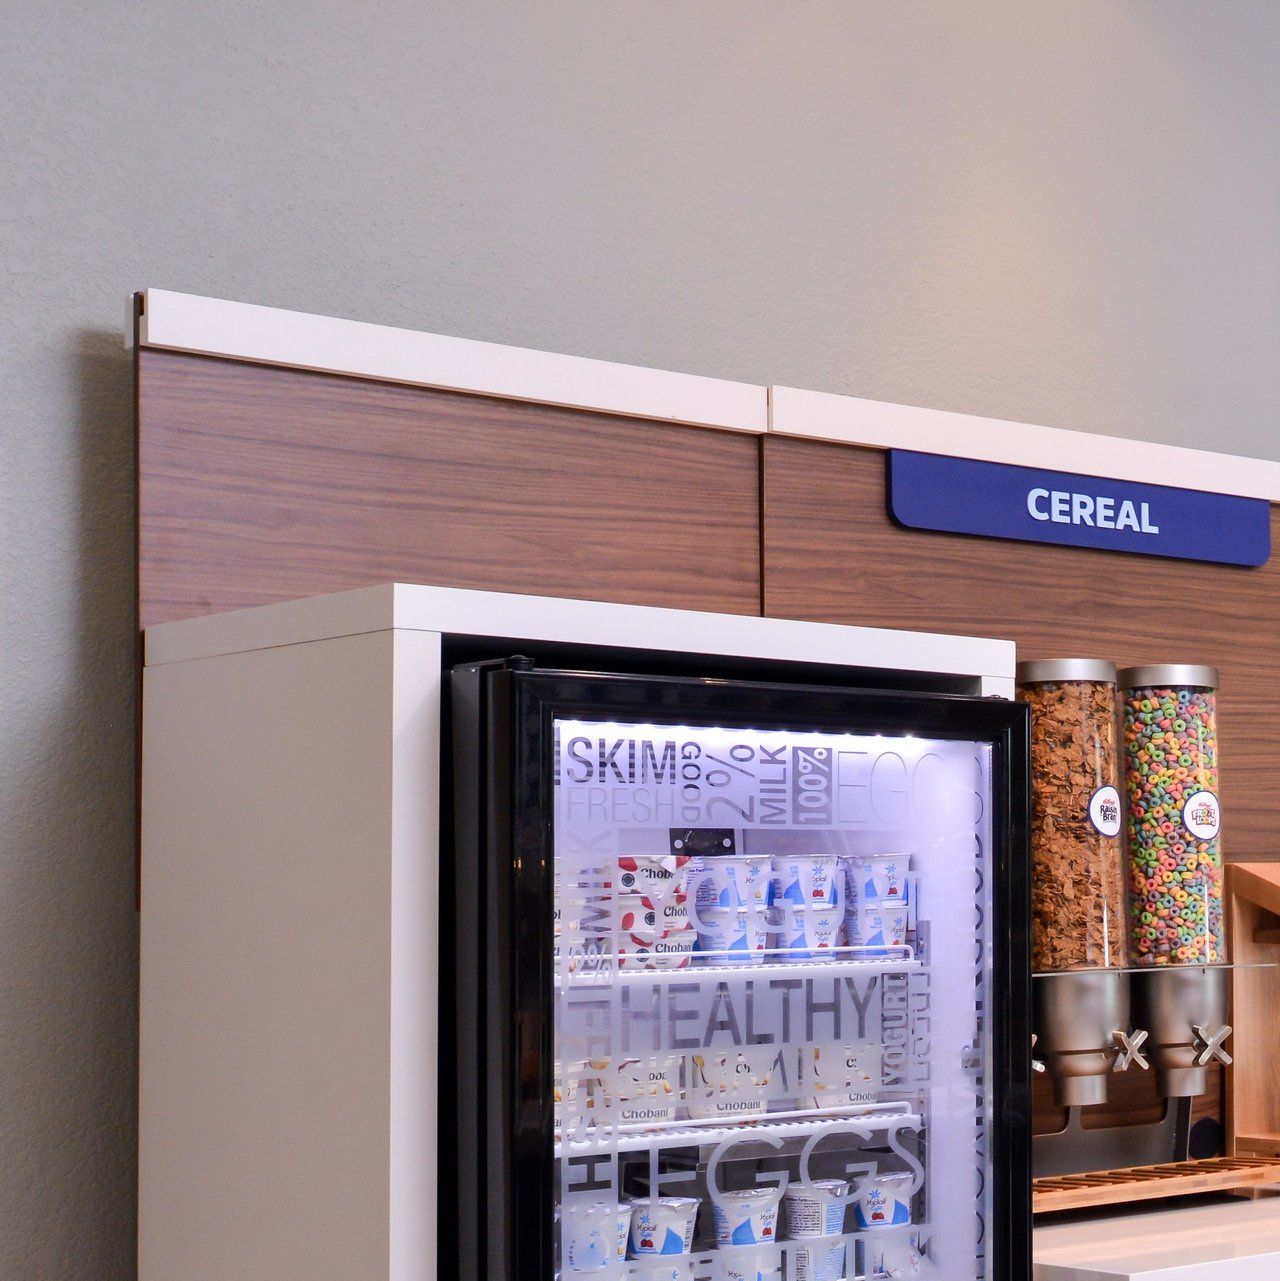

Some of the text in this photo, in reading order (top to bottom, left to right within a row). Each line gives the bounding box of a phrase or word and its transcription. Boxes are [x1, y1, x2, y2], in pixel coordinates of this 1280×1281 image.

[1027, 487, 1159, 535] CEREAL
[567, 736, 676, 785] SKIM
[680, 741, 701, 823] GOOD
[705, 744, 756, 823] 2%
[759, 744, 787, 825] MILK
[566, 786, 676, 824] FRESH
[797, 747, 829, 824] 100%
[1099, 804, 1117, 814] Raisin
[1101, 812, 1117, 821] Bran
[1196, 816, 1217, 827] LOOPS
[621, 976, 878, 1052] HEALTHY
[621, 1107, 669, 1120] Chobani
